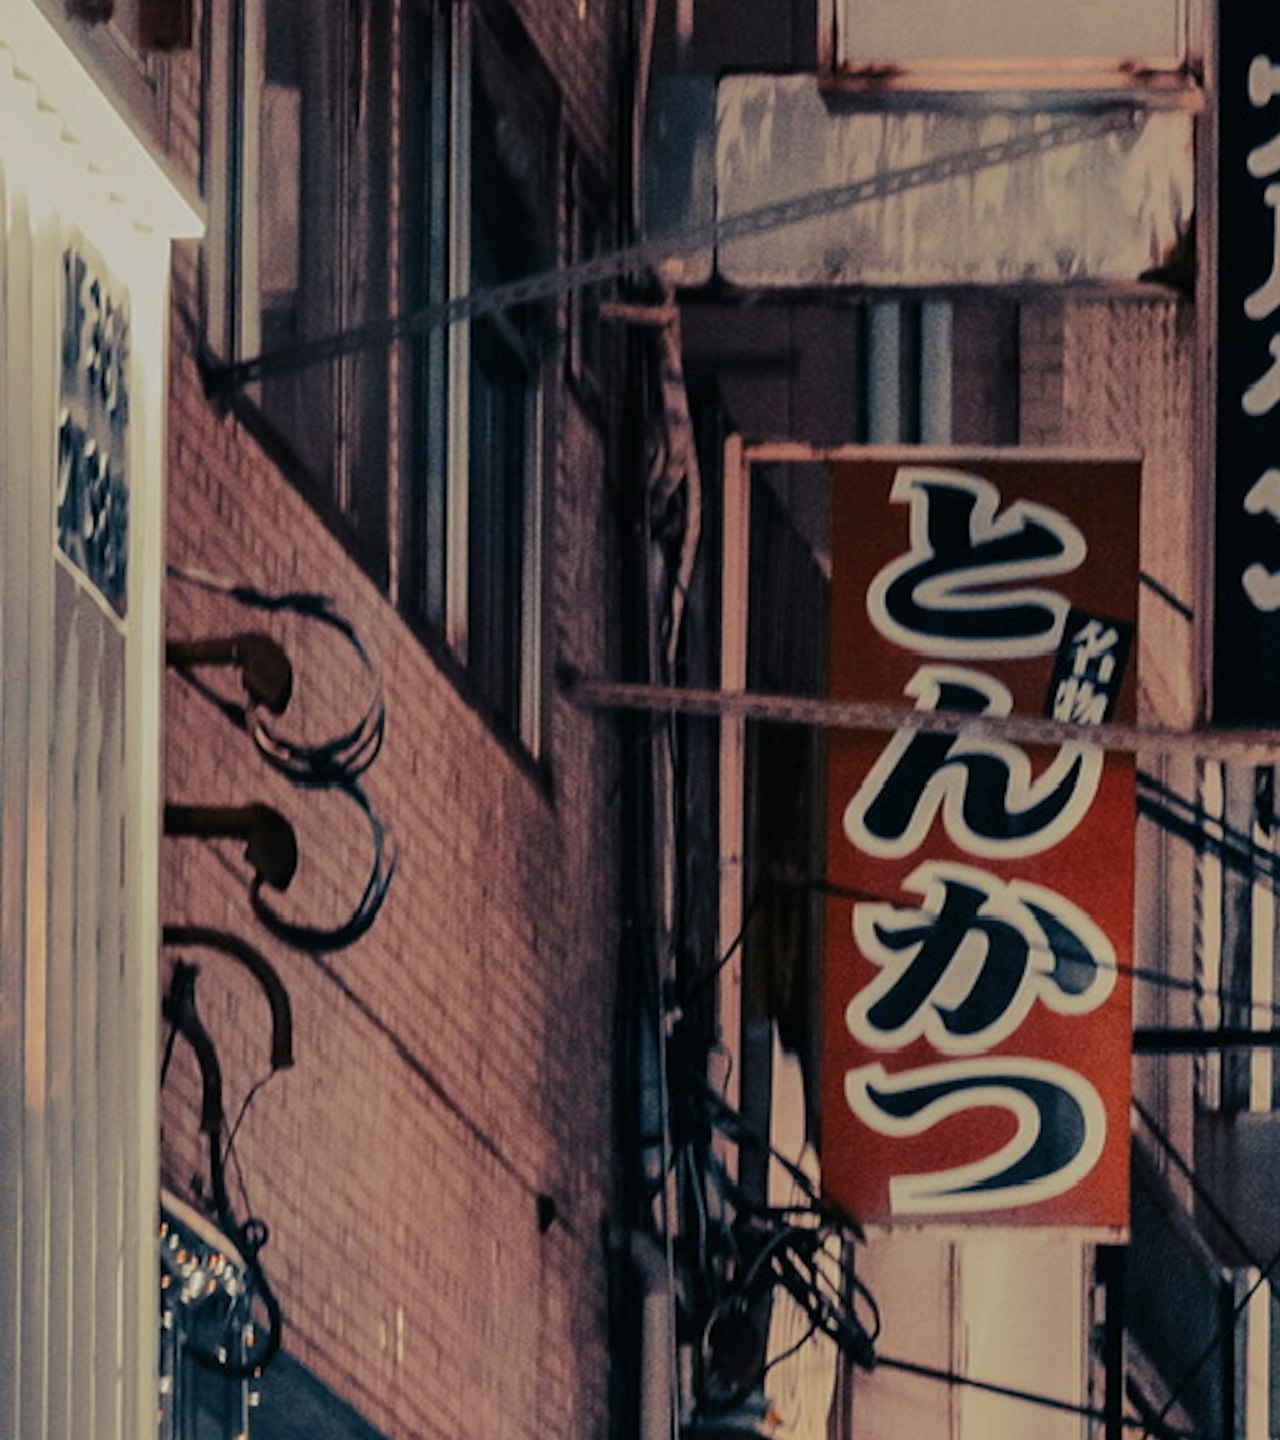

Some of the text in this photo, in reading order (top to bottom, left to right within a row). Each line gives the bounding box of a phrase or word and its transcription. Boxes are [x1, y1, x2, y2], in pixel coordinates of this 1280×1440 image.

[843, 465, 1118, 1215] とんかつ
[1053, 618, 1120, 724] 名物
